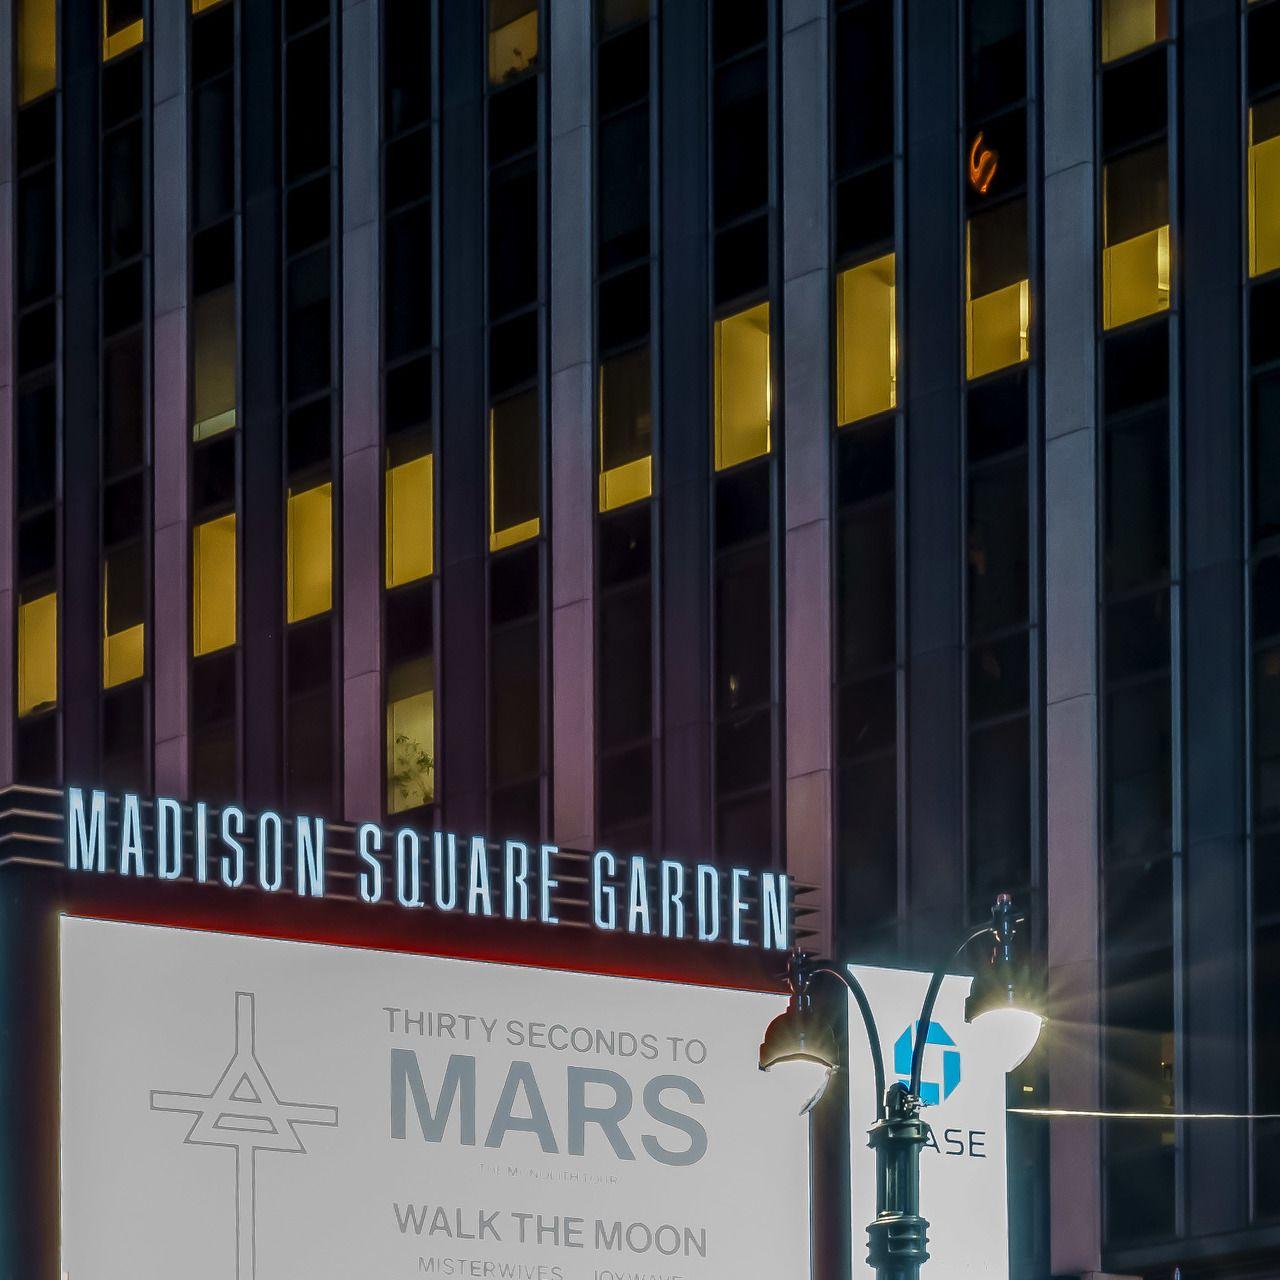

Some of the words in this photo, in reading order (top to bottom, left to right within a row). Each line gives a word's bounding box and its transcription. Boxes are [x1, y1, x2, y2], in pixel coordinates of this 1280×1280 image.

[67, 786, 325, 897] MADISON
[359, 823, 560, 924] SQUARE
[594, 849, 789, 950] GARDEN
[382, 1007, 497, 1042] THIRTY
[505, 1020, 660, 1060] SECONDS
[666, 1036, 708, 1065] TO
[390, 1048, 708, 1166] MARS
[923, 1128, 987, 1158] ASE
[393, 1202, 502, 1241] WALK
[511, 1212, 585, 1248] THE
[594, 1219, 707, 1258] MOON
